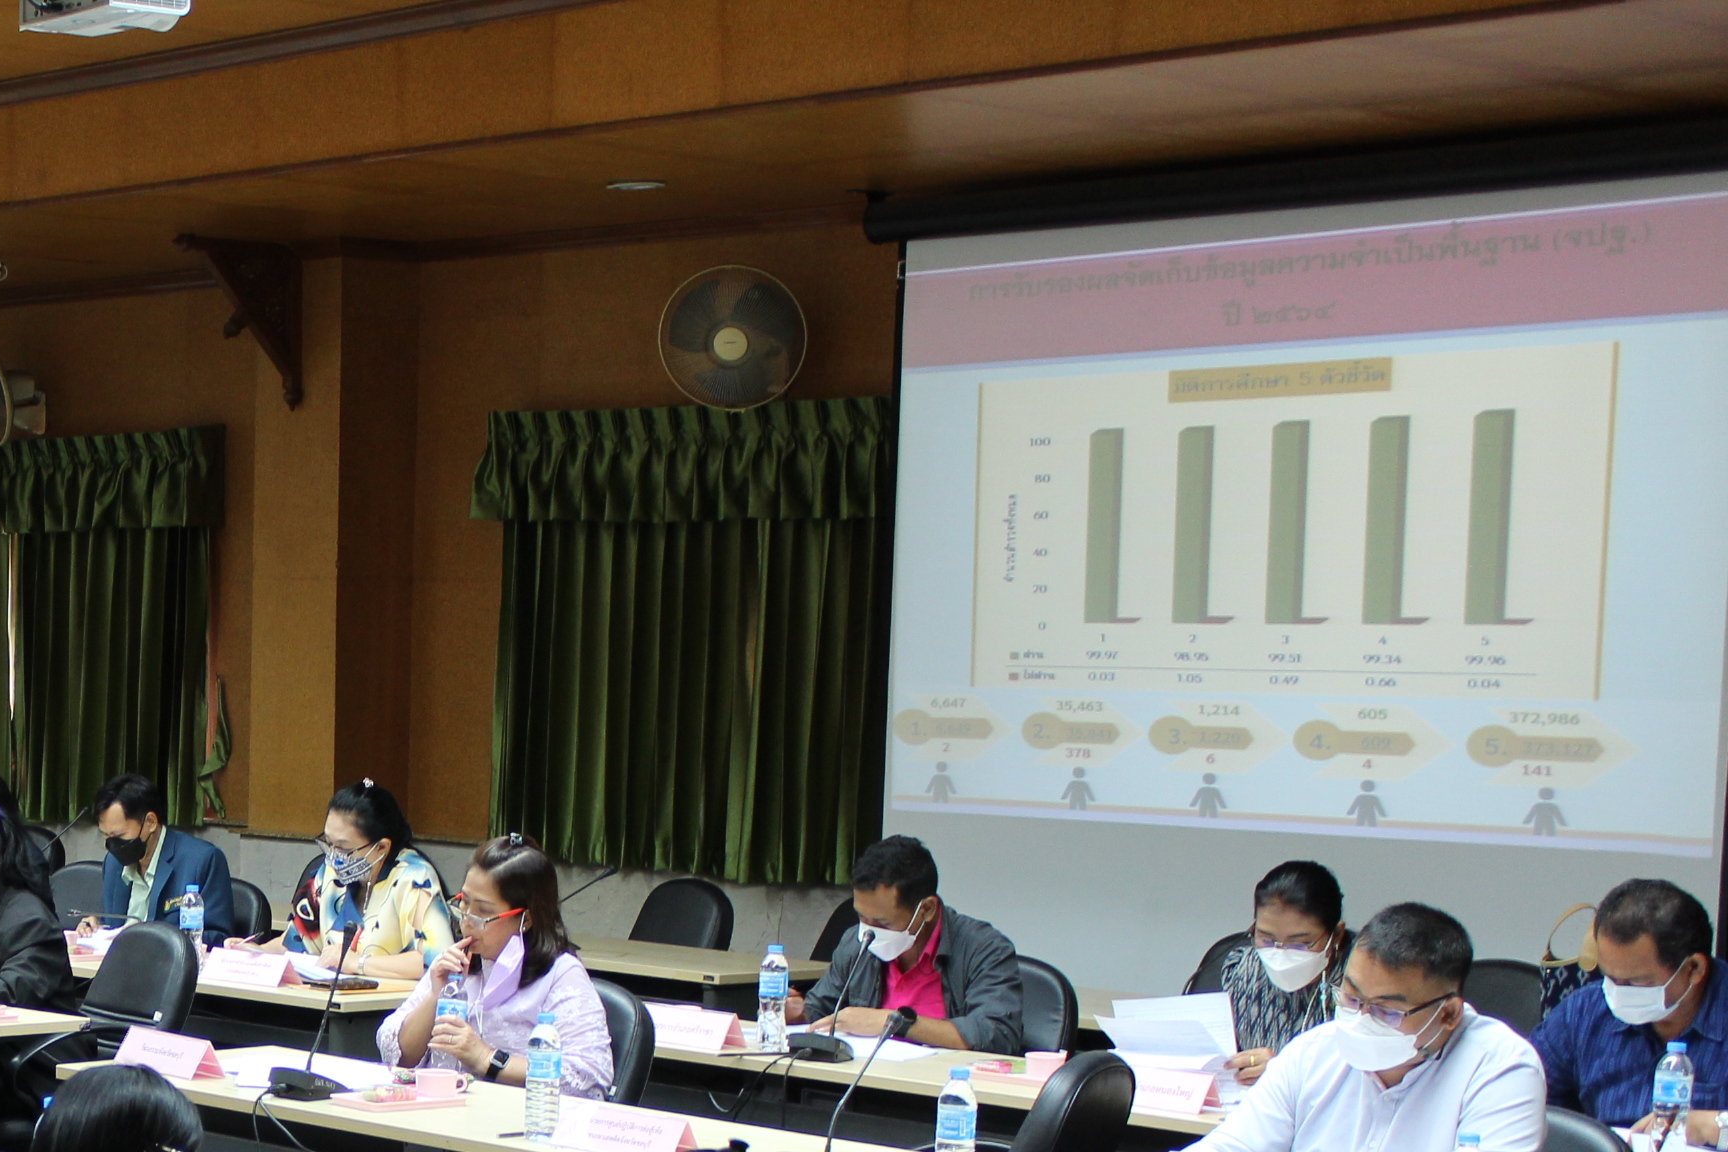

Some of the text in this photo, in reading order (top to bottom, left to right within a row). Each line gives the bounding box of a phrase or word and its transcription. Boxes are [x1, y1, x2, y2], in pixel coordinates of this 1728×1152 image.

[1223, 300, 1243, 327] ปี
[1299, 370, 1315, 387] 5
[1029, 437, 1051, 447] 100
[1034, 473, 1051, 483] 80
[1033, 511, 1049, 520] 60
[1032, 548, 1048, 557] 40
[1032, 585, 1048, 594] 20
[1038, 621, 1046, 631] 0
[1268, 653, 1302, 663] 99.51
[1362, 654, 1402, 665] 99.34
[1088, 672, 1116, 682] 0.03
[1176, 673, 1203, 684] 1.05
[1365, 676, 1397, 687] 0.66
[1467, 678, 1501, 689] 0.04
[929, 697, 967, 709] 6,647
[1055, 700, 1103, 712] 35,463
[1198, 704, 1240, 717] 1,214
[1357, 708, 1388, 720] 605
[1509, 711, 1580, 726] 372,986
[911, 721, 928, 737] 1.
[1032, 723, 1051, 739] 2.
[1168, 728, 1187, 745] 3.
[1309, 733, 1331, 750] 4.
[942, 743, 951, 753] 2
[1484, 737, 1508, 756] 5.
[1065, 747, 1091, 759] 378
[1205, 753, 1215, 764] 6
[1362, 758, 1373, 769] 4
[1522, 764, 1553, 776] 141
